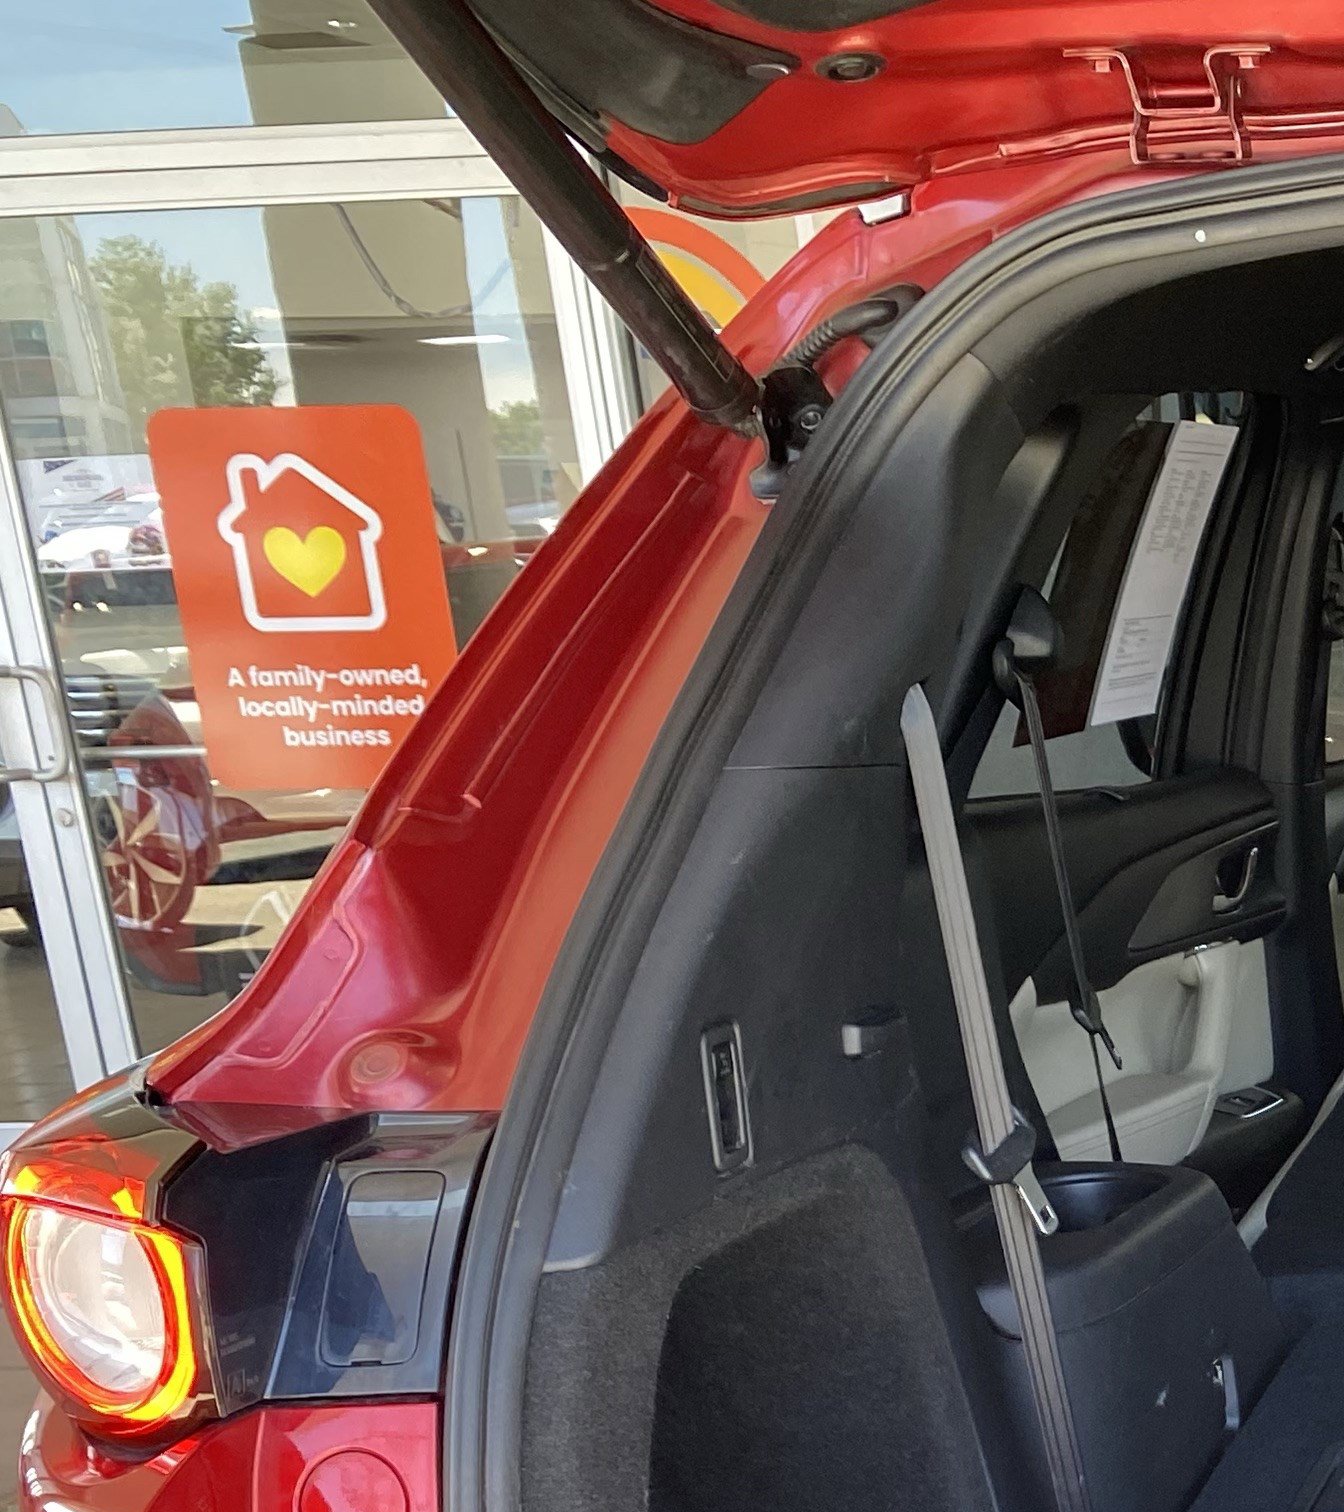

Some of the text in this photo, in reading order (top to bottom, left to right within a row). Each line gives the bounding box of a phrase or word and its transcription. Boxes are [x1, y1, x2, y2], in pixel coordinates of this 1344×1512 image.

[228, 664, 427, 693] A family-owned,
[238, 694, 425, 722] locally-minded
[283, 725, 391, 746] business
